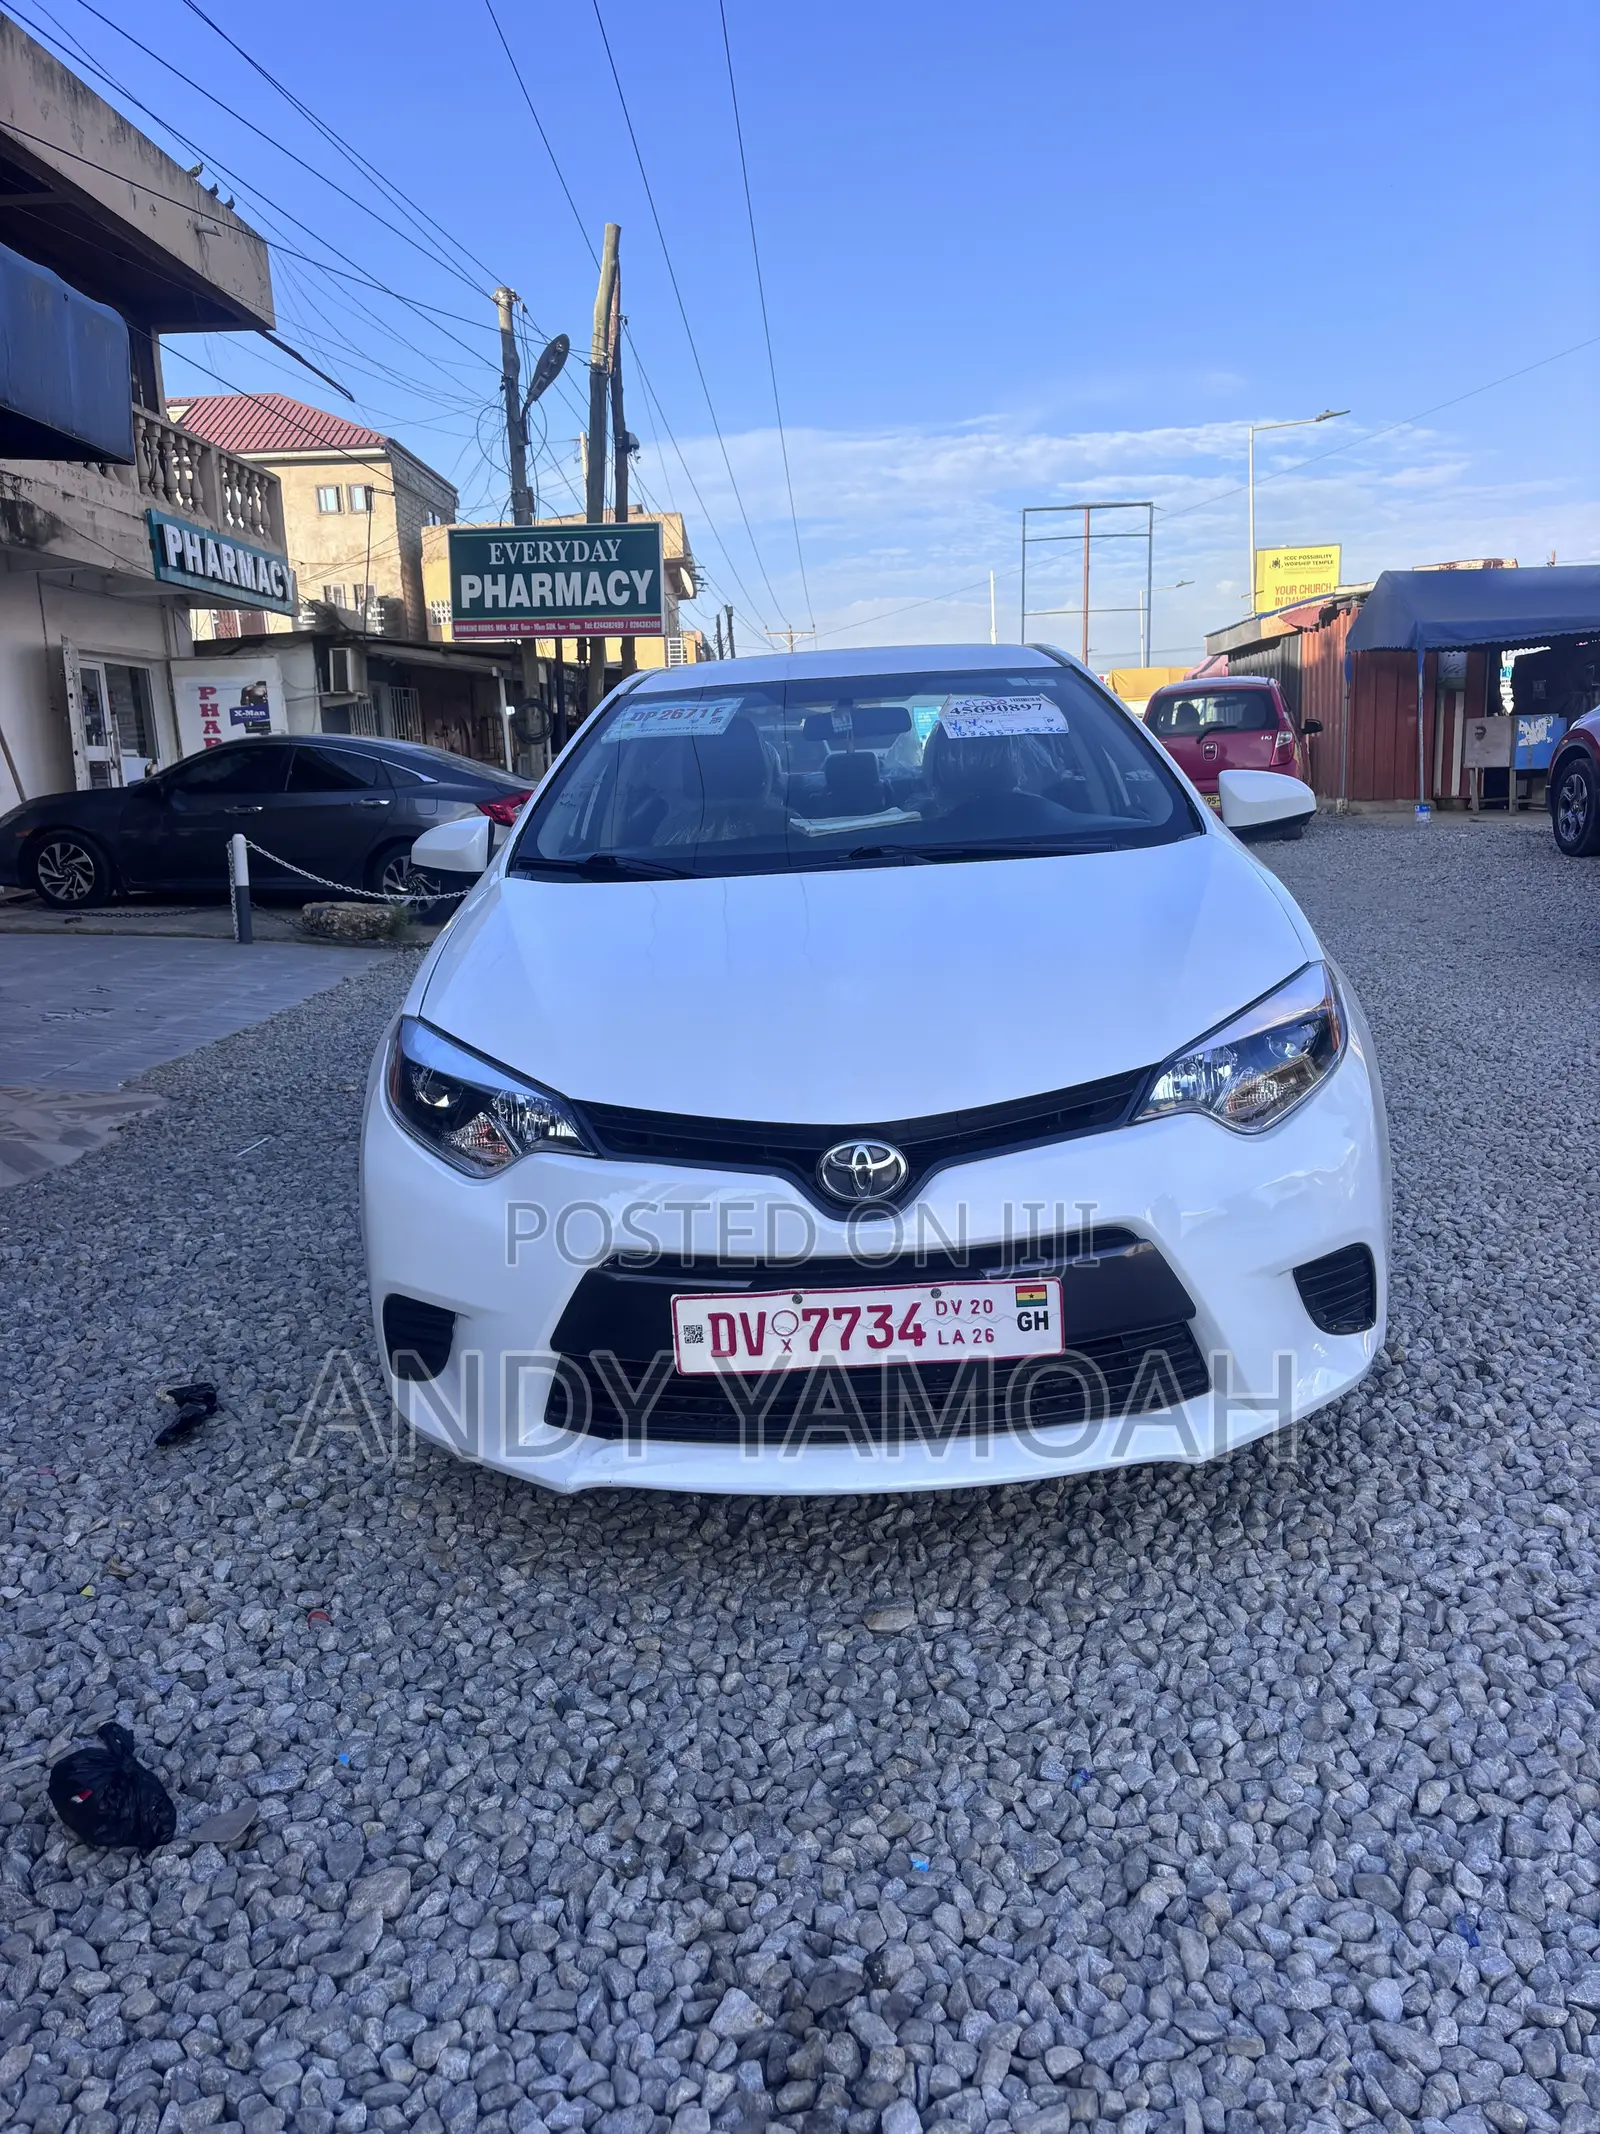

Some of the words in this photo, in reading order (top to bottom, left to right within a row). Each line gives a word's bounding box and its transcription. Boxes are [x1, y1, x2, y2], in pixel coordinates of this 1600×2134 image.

[488, 538, 622, 566] EVERYDAY
[163, 523, 296, 601] PHARMACY
[460, 568, 654, 609] PHARMACY
[1274, 585, 1298, 596] YOUR
[1299, 582, 1332, 595] CHURCH
[1275, 596, 1284, 606] IN
[234, 709, 266, 717] X-Man
[657, 707, 709, 721] 2671
[935, 1300, 963, 1316] DV
[970, 1298, 994, 1315] 20
[708, 1310, 768, 1358] DV
[801, 1301, 927, 1352] 7734
[1016, 1310, 1050, 1332] GH
[937, 1330, 966, 1346] LA
[972, 1327, 995, 1344] 26
